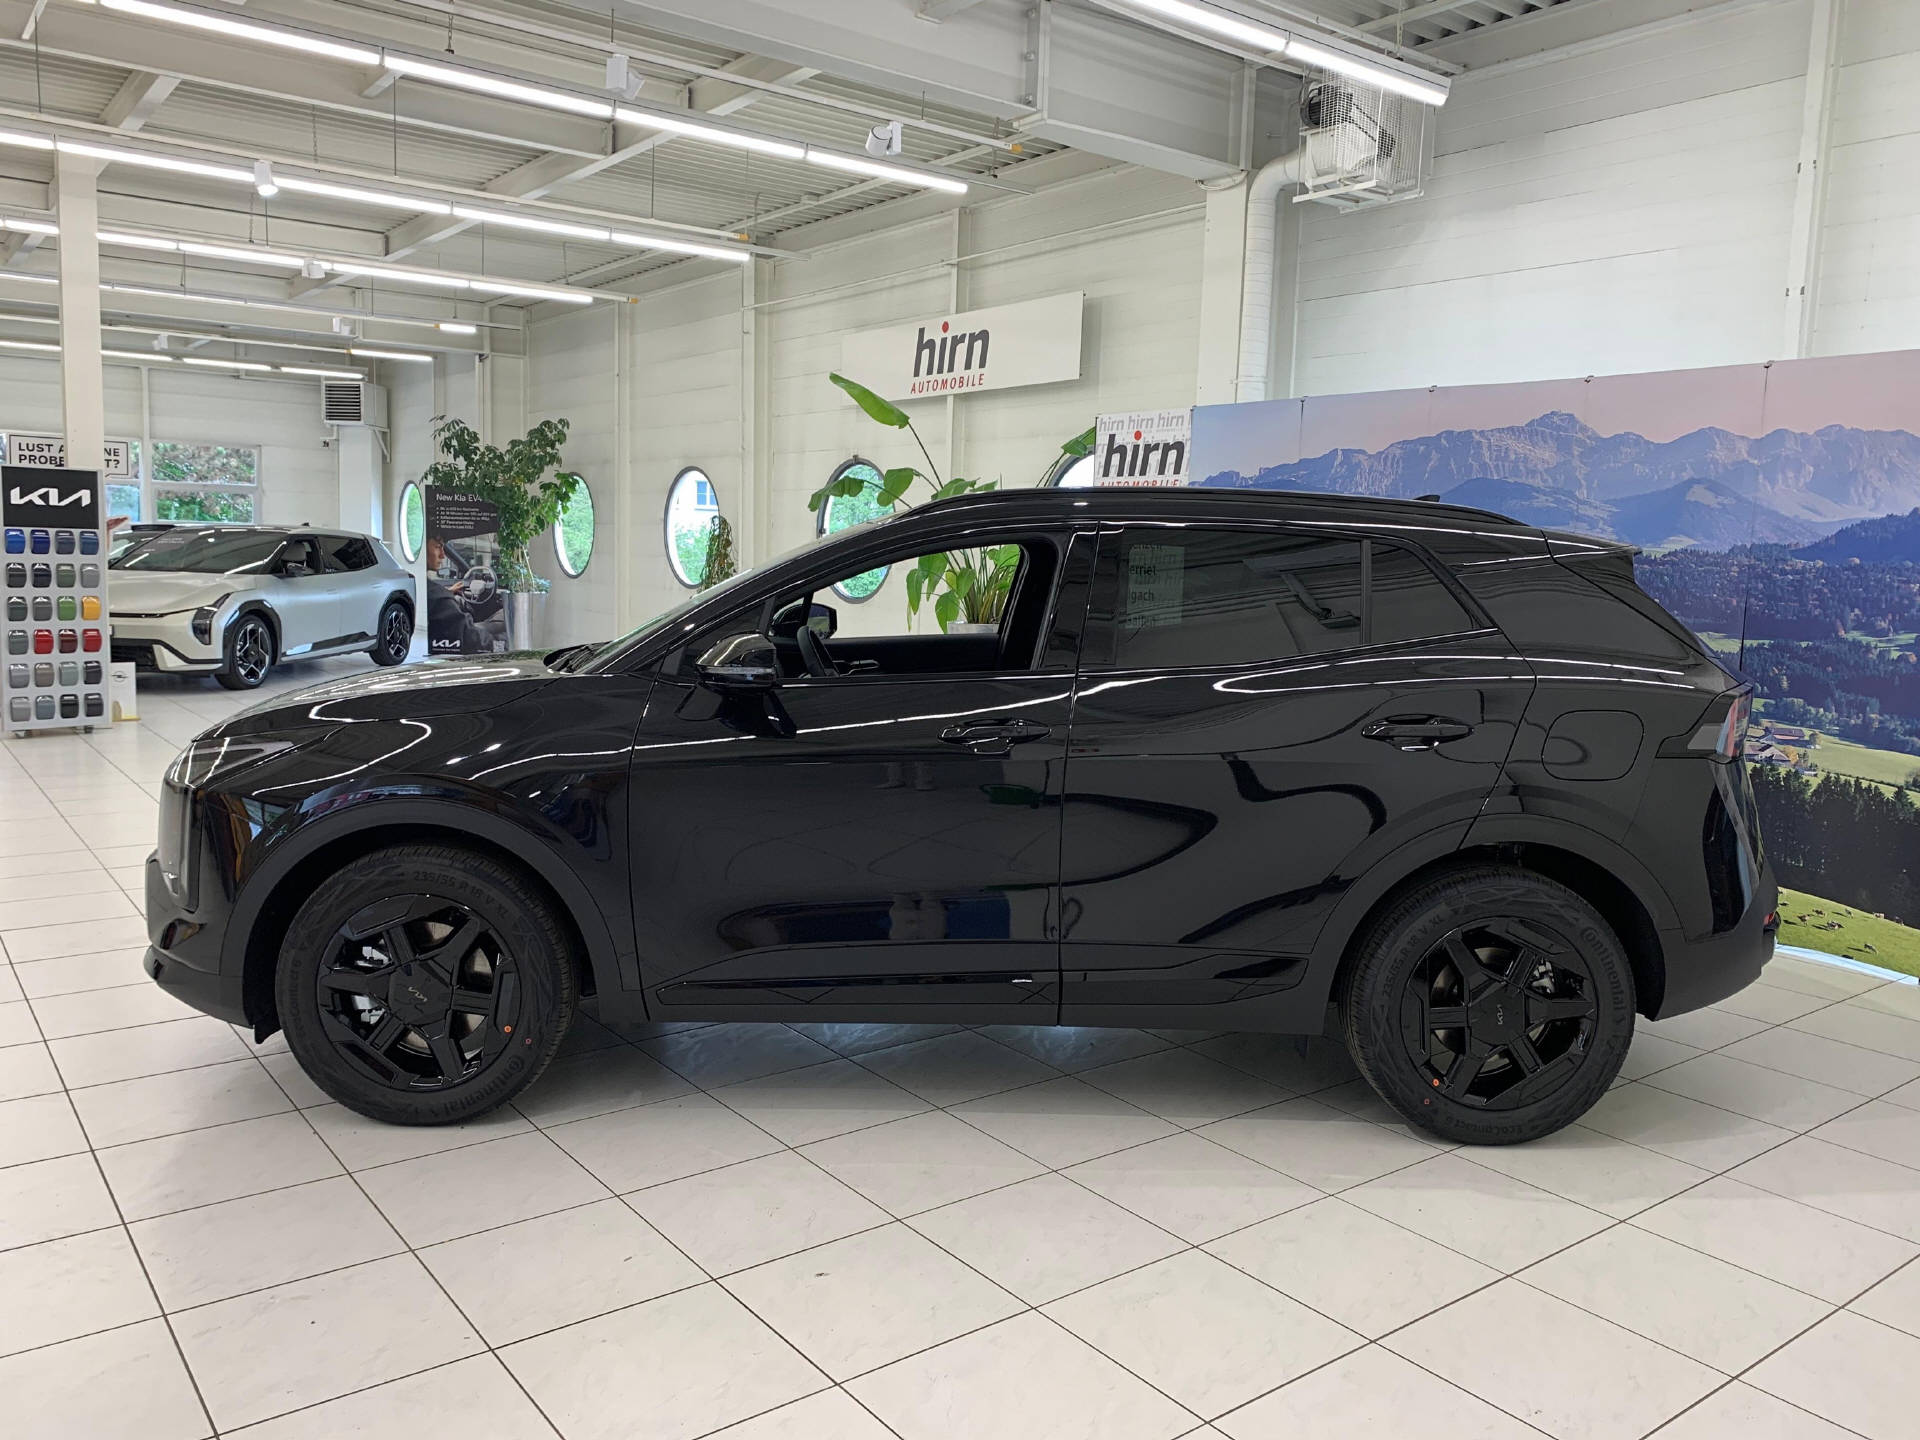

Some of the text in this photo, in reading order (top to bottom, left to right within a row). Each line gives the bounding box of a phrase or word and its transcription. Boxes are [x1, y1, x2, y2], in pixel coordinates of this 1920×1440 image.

[914, 321, 989, 377] hirn
[911, 374, 985, 394] AUTOMOBILE
[18, 442, 54, 453] LUST
[1102, 430, 1185, 478] hirn
[10, 486, 91, 508] KIA
[436, 493, 453, 502] New
[454, 494, 467, 502] Kia
[432, 639, 460, 648] KIA
[1579, 927, 1627, 1011] Continental
